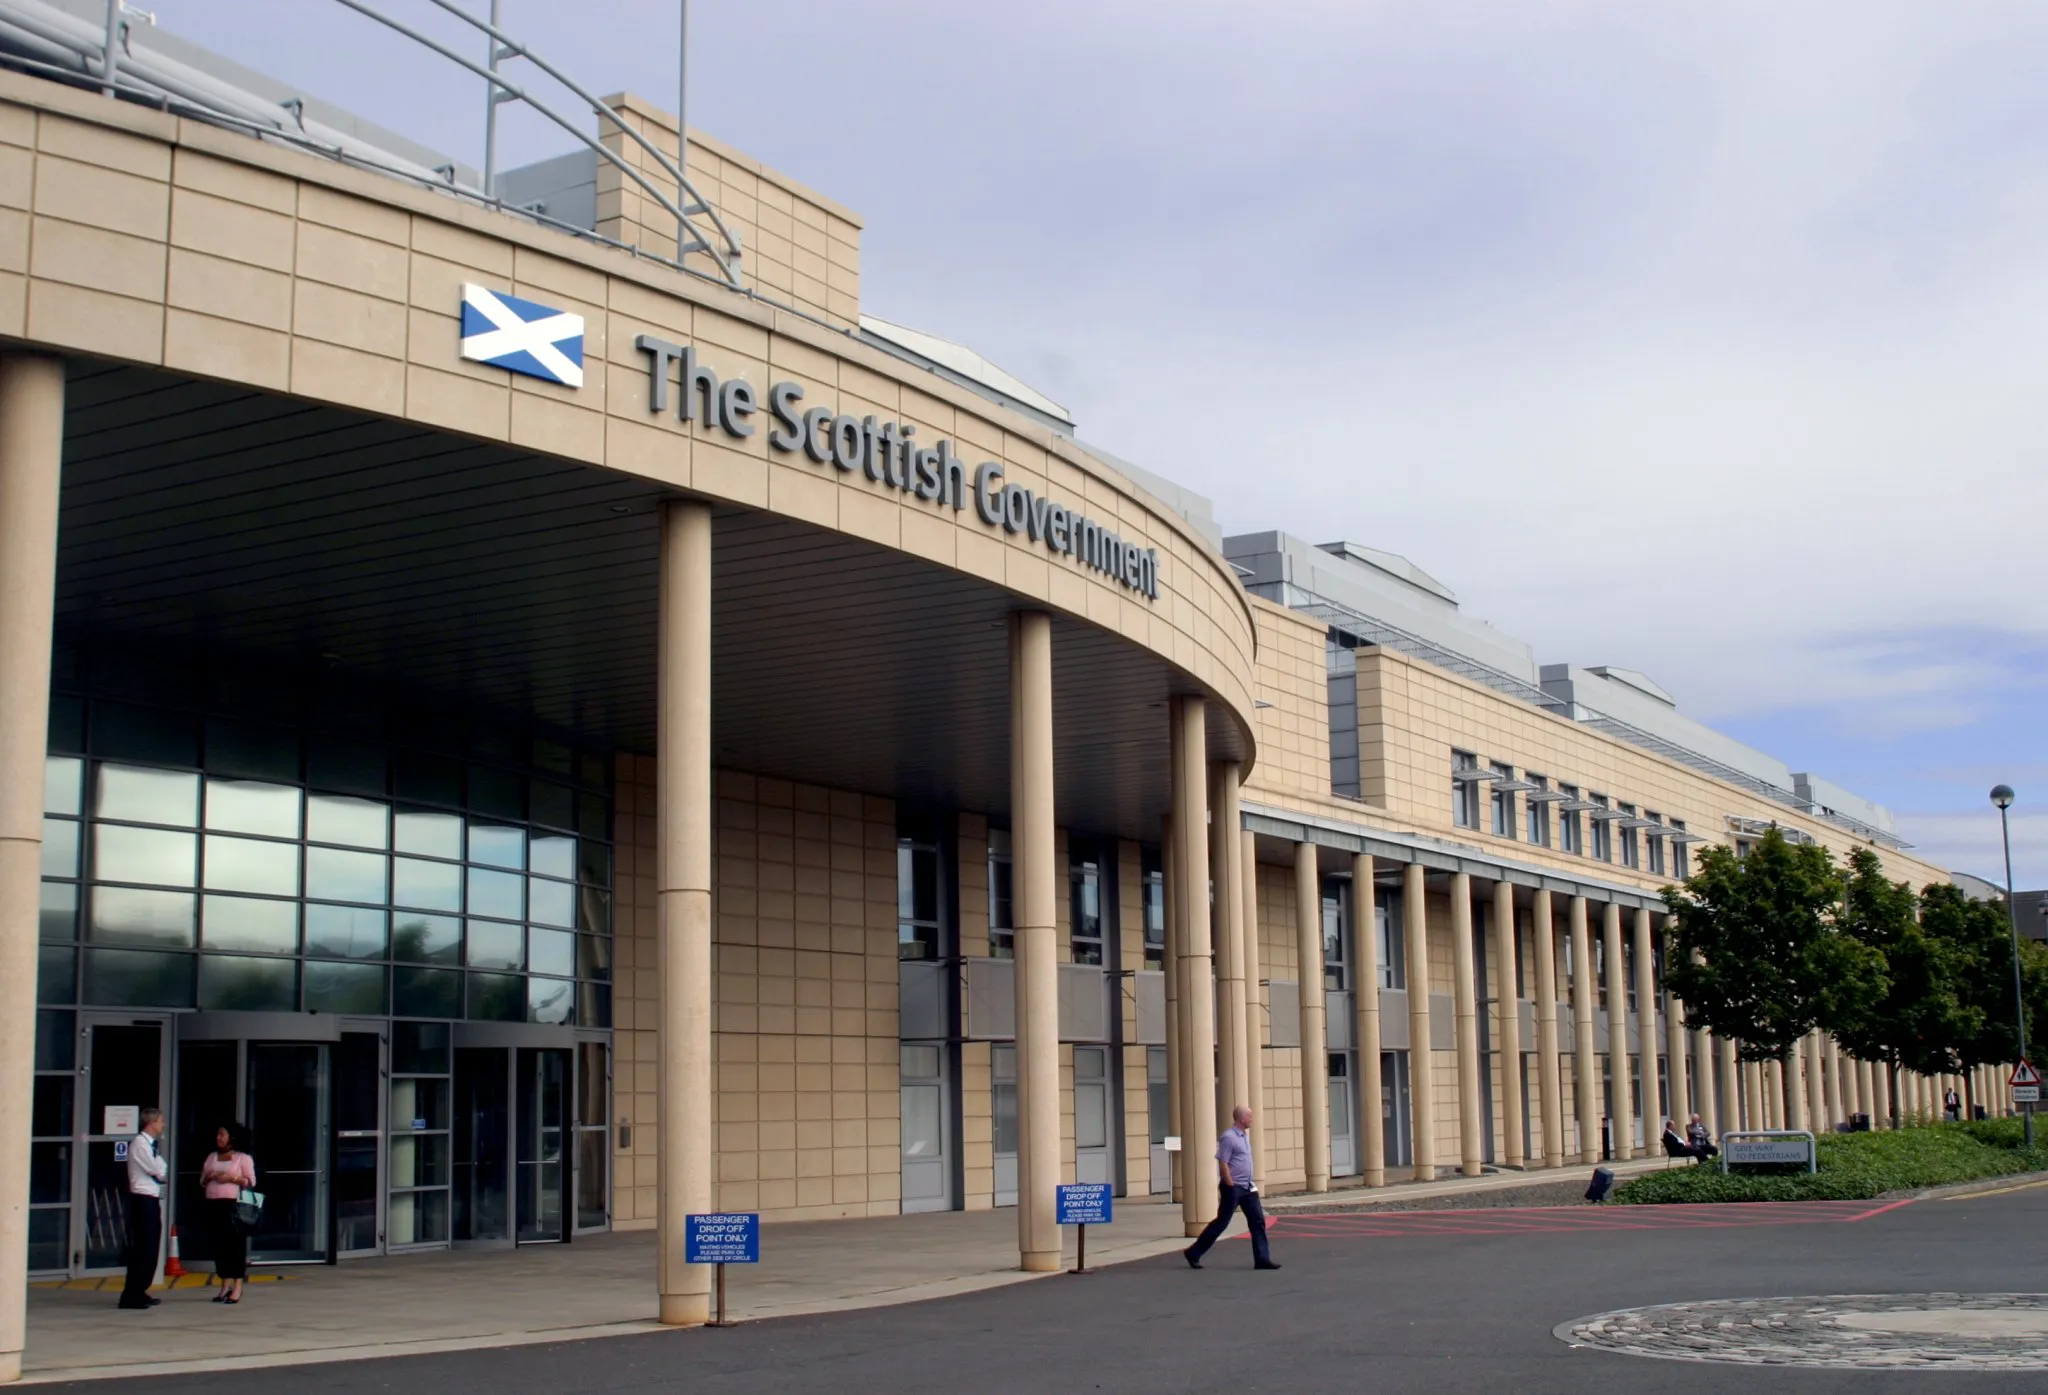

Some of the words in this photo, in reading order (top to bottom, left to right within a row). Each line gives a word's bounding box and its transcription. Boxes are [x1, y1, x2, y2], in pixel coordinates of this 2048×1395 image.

[636, 334, 757, 438] The
[769, 382, 967, 512] Scottish
[975, 462, 1160, 600] Government
[1062, 1185, 1105, 1193] PASSENGER
[1063, 1200, 1085, 1208] POINT
[1085, 1199, 1104, 1207] ONLY
[694, 1215, 750, 1224] PASSENGER
[699, 1225, 725, 1233] DROP
[726, 1224, 745, 1233] OFF
[695, 1234, 723, 1242] POINT
[724, 1234, 748, 1242] ONLY
